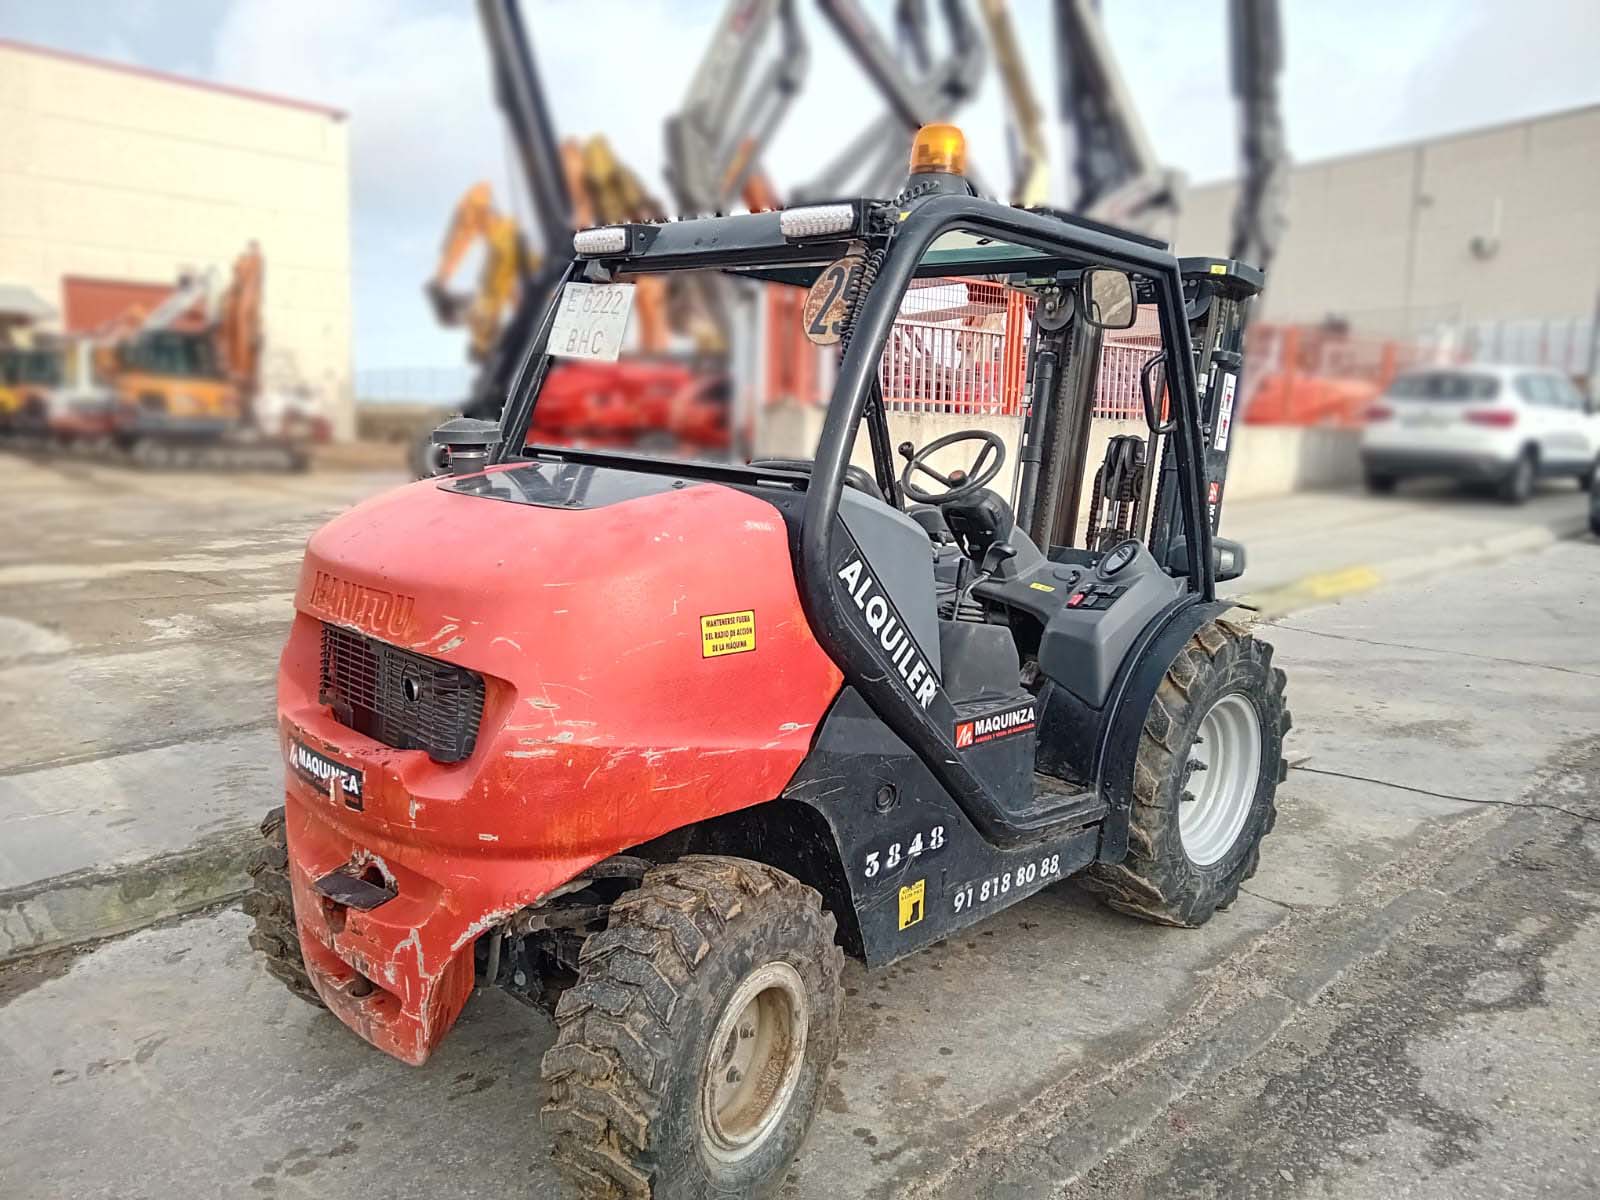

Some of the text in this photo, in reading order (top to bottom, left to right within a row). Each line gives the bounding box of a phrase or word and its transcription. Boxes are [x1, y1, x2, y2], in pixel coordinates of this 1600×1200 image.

[566, 288, 582, 312] E
[566, 328, 604, 354] BHC
[714, 630, 729, 639] RADIO
[719, 643, 725, 651] LA
[838, 559, 937, 710] ALQUILER
[975, 707, 1035, 736] MAQUINZA
[954, 855, 1059, 913] 91 818 80 88
